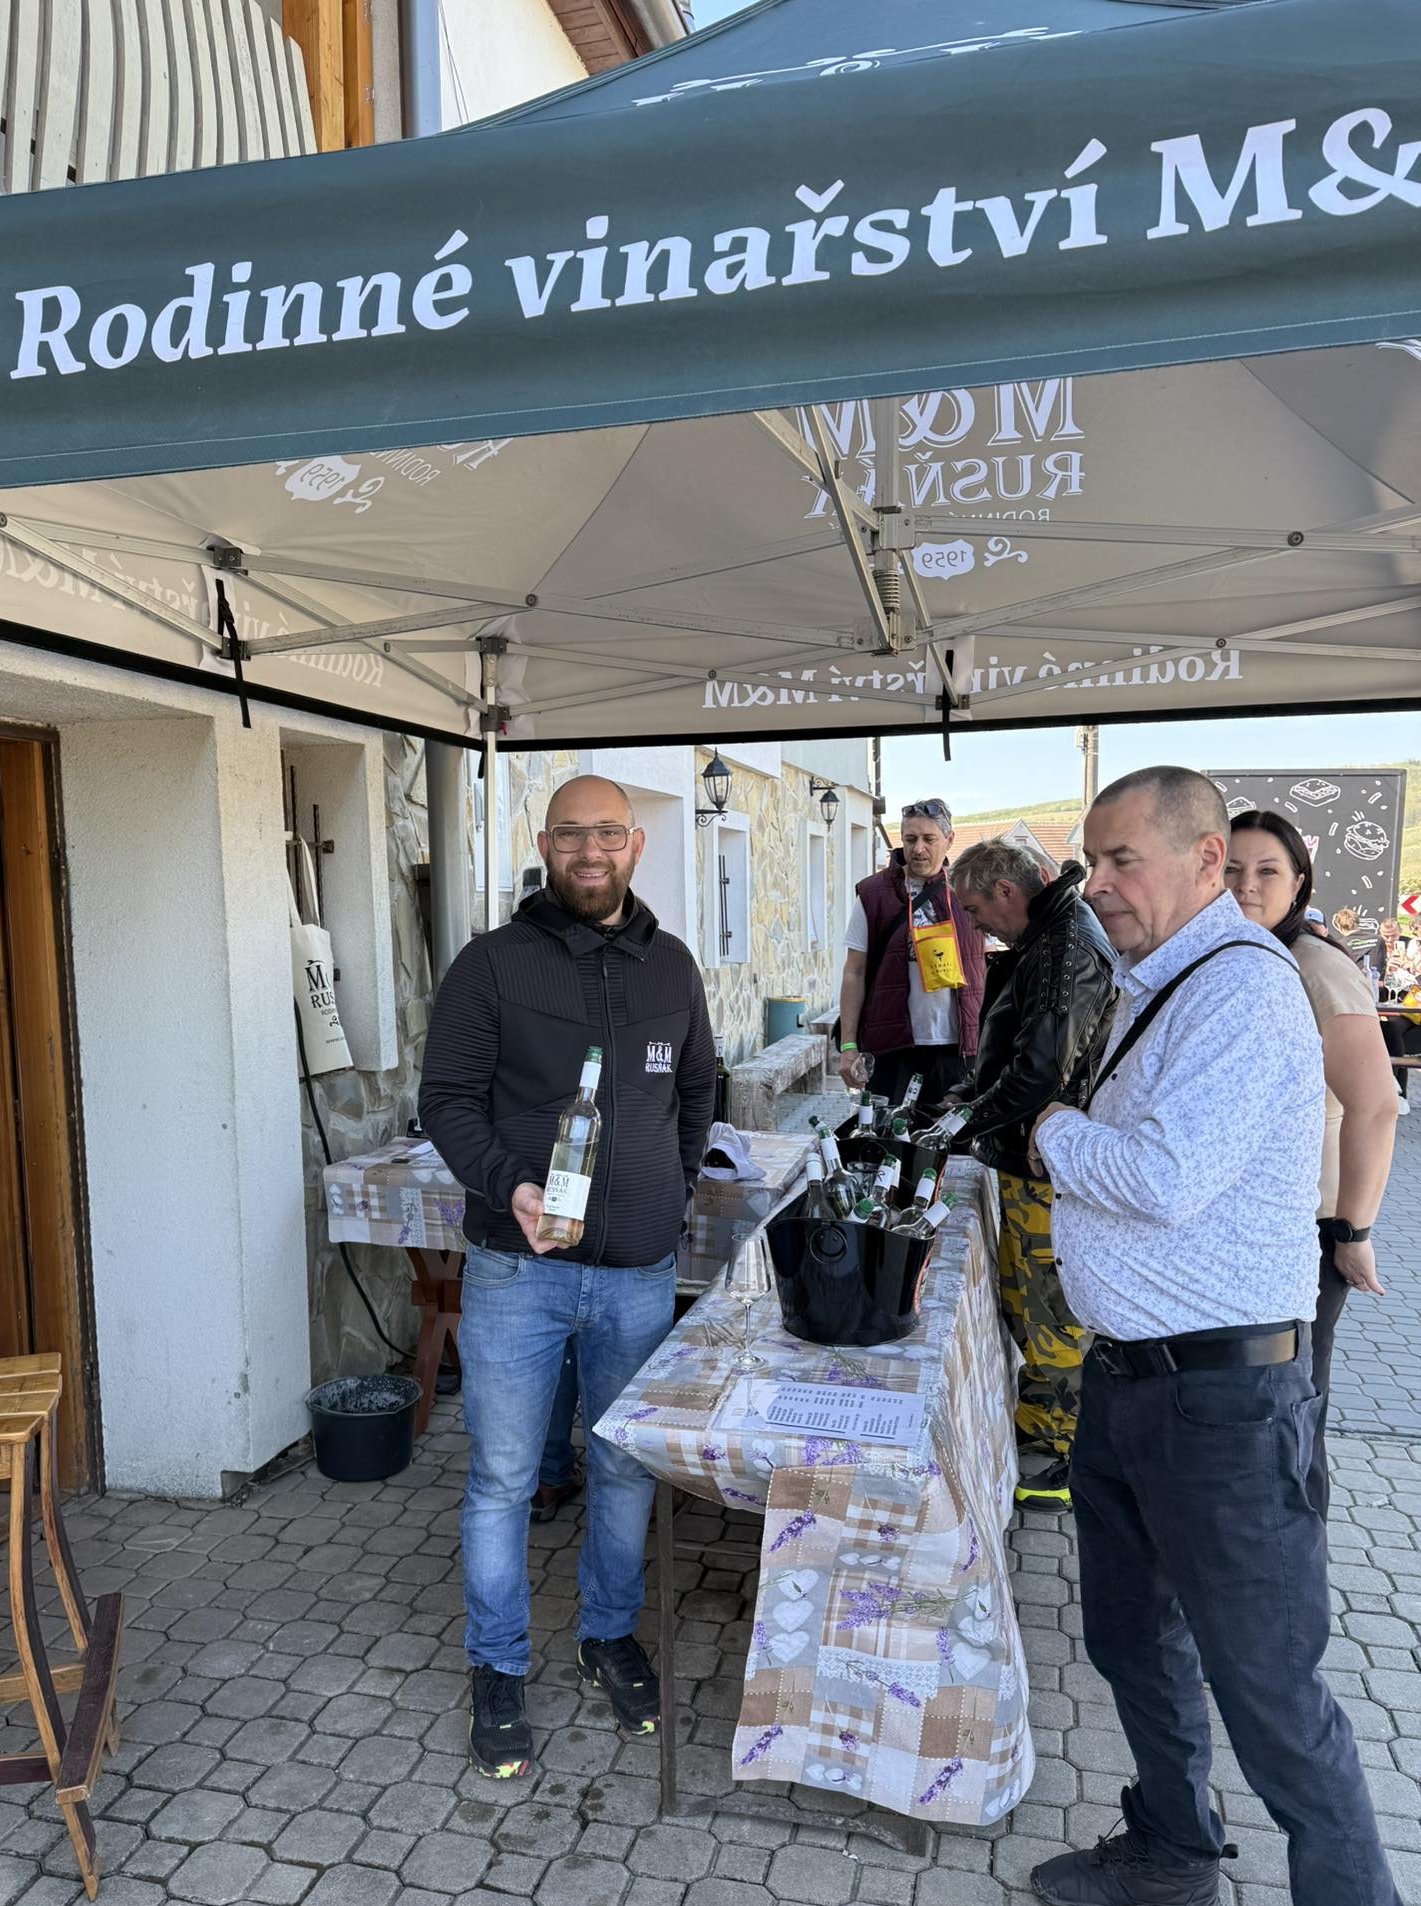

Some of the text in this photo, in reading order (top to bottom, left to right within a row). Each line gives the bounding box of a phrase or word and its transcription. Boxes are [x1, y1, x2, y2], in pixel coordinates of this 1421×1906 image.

[9, 228, 472, 379] Rodinné
[504, 138, 1107, 319] vinařství
[646, 1045, 672, 1063] M&M
